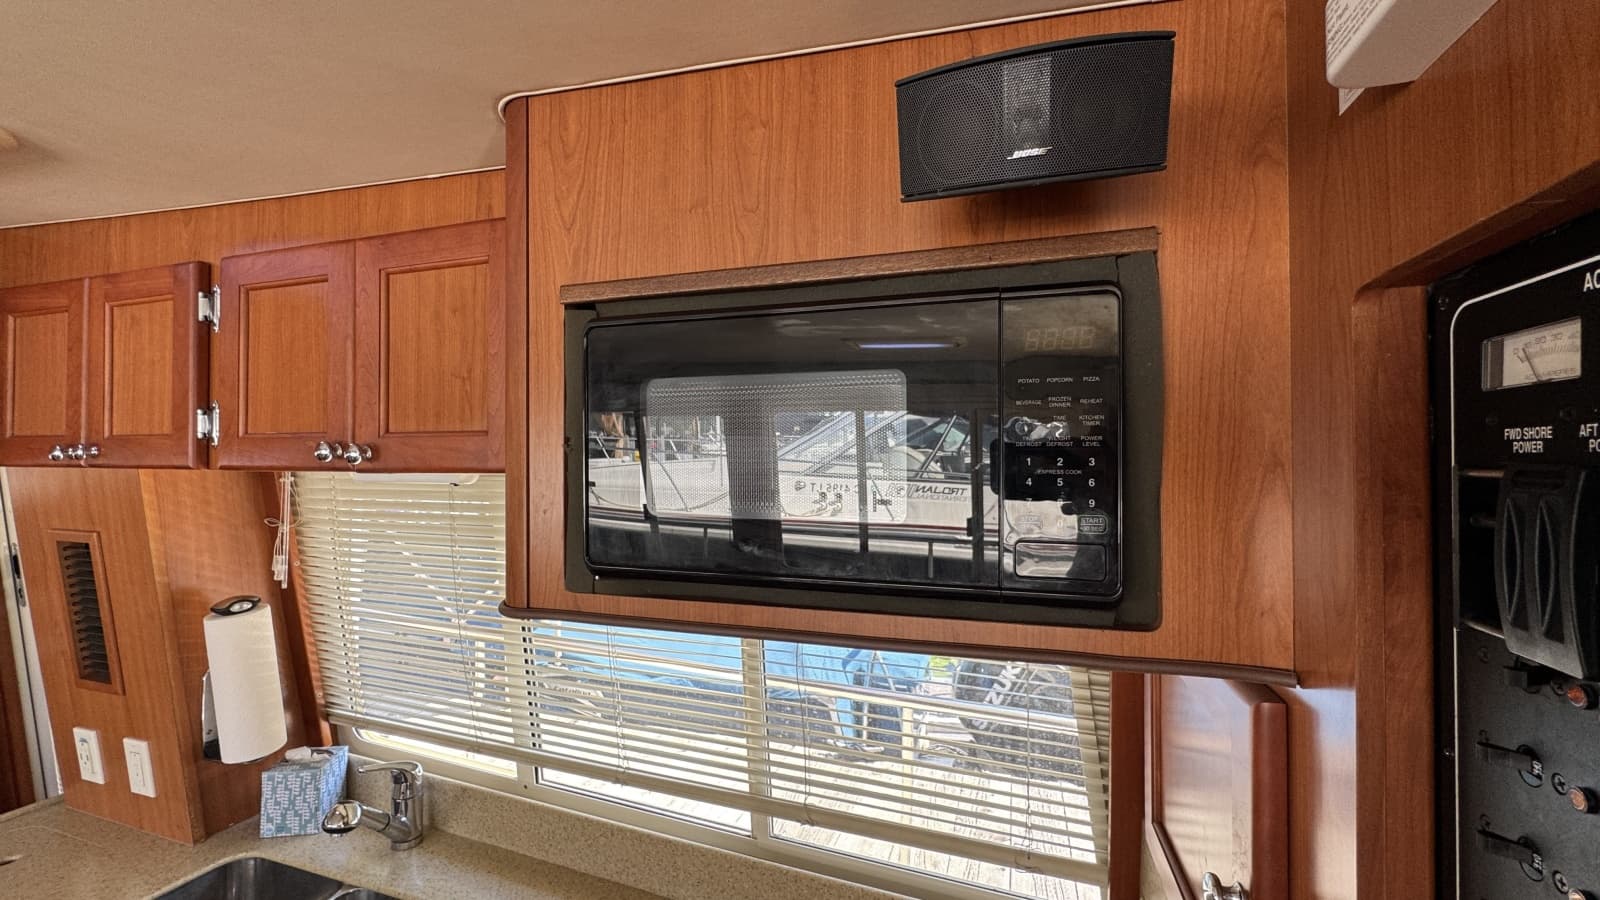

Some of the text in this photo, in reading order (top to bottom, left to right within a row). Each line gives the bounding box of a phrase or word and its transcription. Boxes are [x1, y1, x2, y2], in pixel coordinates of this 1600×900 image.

[1006, 146, 1053, 160] BOSE
[1504, 426, 1553, 440] FWD SHORE
[1579, 423, 1599, 438] AFT
[1512, 440, 1544, 454] POWER
[1026, 457, 1031, 467] 1
[1056, 457, 1064, 466] 2
[1088, 457, 1096, 466] 3
[1025, 477, 1033, 487] 4
[1056, 477, 1064, 487] 5
[1088, 478, 1096, 487] 6
[1088, 498, 1096, 508] 9
